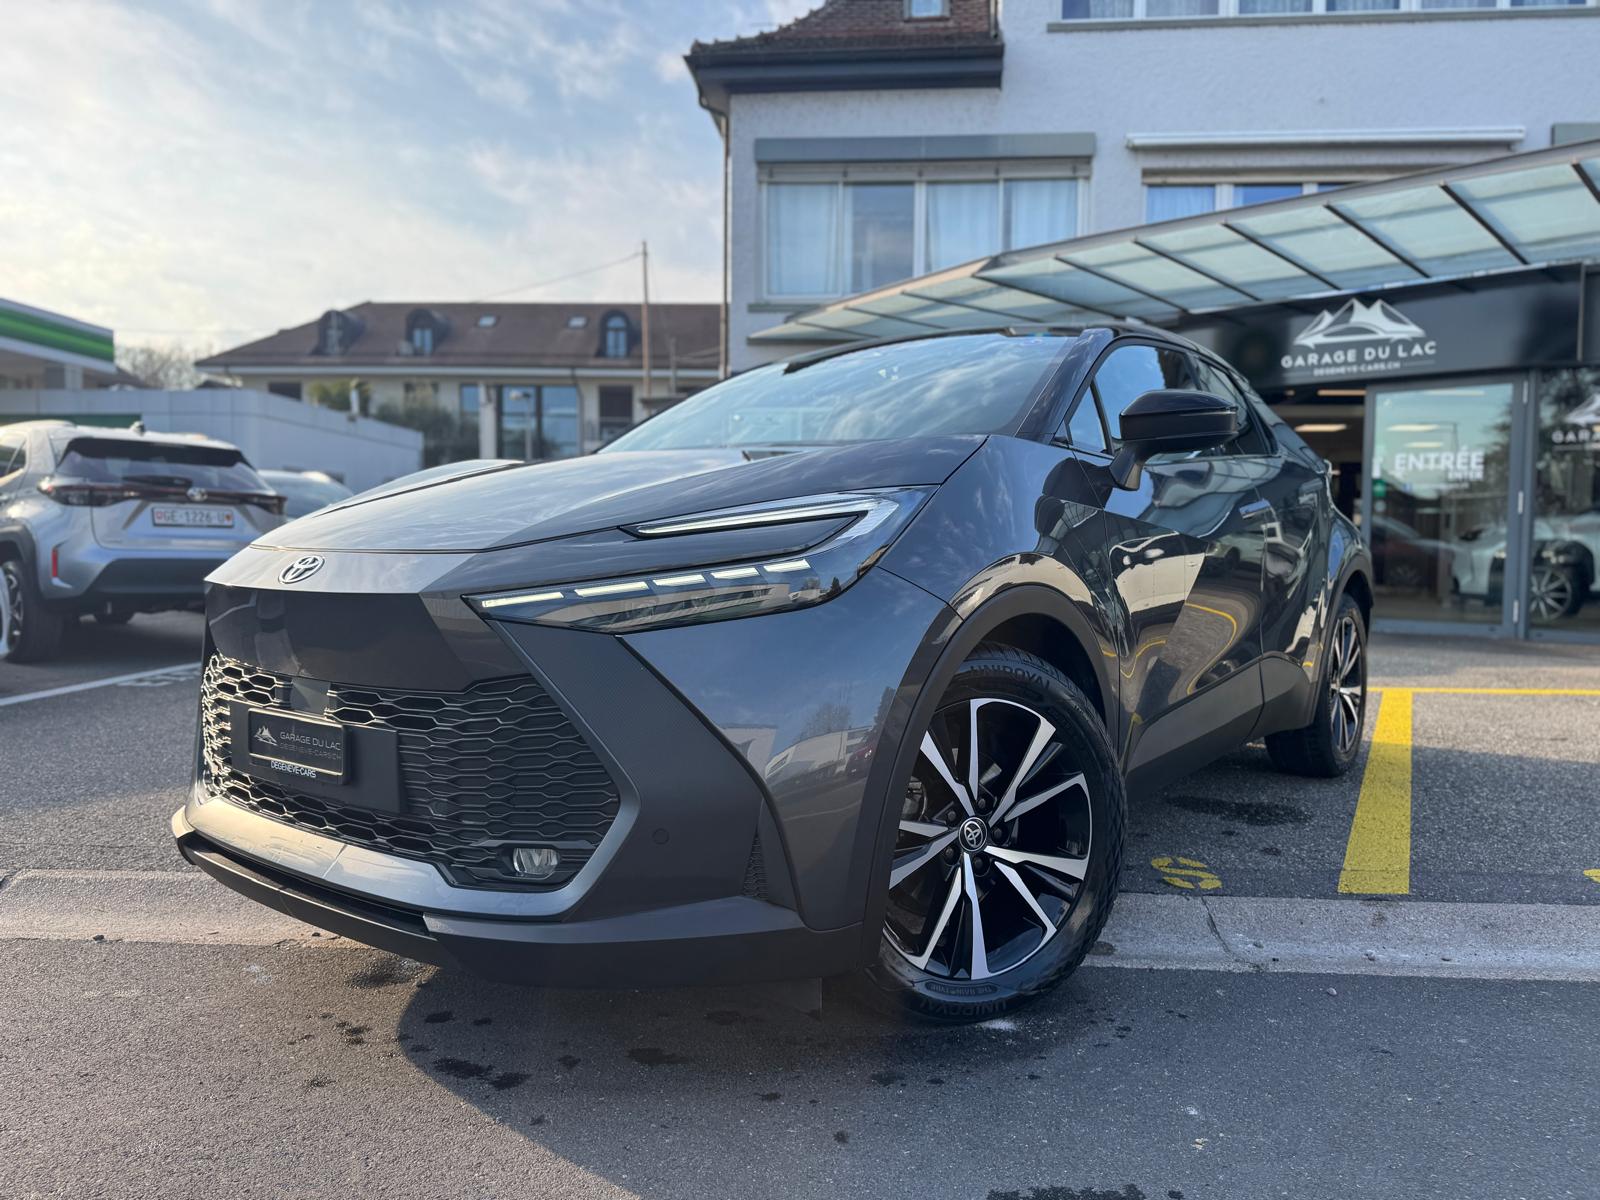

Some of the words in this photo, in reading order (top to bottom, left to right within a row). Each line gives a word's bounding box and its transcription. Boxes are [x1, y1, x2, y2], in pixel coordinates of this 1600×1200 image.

[1281, 349, 1357, 368] GARAGE
[1364, 346, 1390, 361] DU
[1398, 341, 1437, 357] LAC
[1394, 446, 1484, 471] ENTRÉE
[279, 731, 312, 745] GARAGE
[312, 738, 325, 747] DU
[325, 739, 342, 751] LAC
